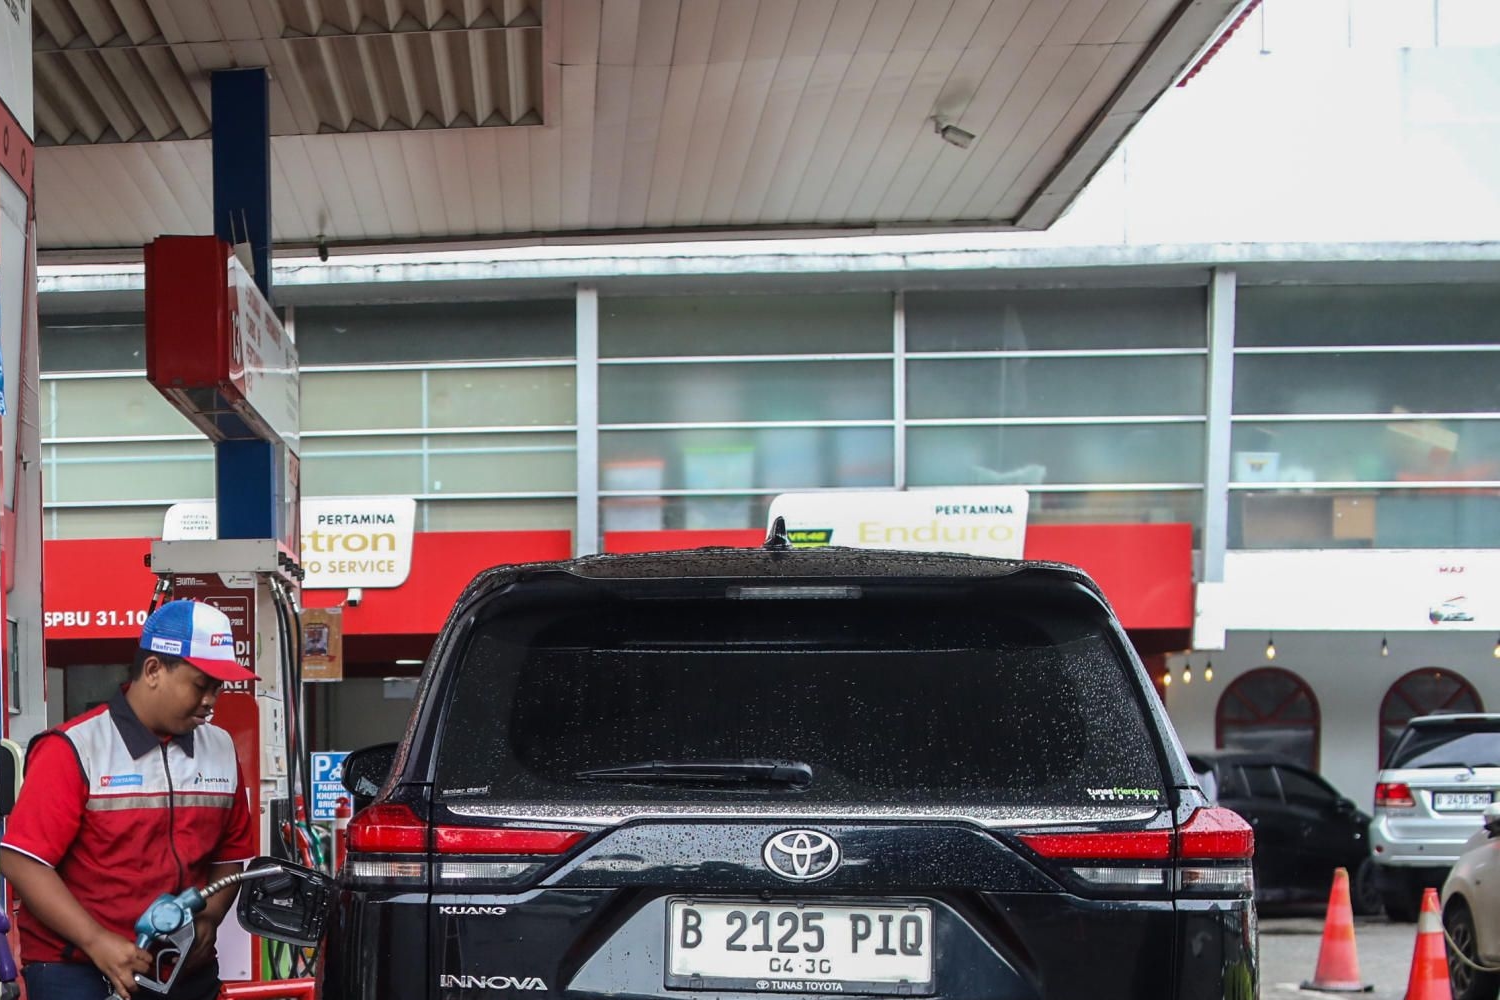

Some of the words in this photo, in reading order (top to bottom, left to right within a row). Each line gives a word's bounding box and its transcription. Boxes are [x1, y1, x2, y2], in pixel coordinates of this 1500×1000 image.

[935, 505, 1013, 514] PERTAMINA
[318, 514, 396, 526] PERTAMINA
[858, 520, 1014, 544] Enduro
[300, 529, 396, 552] tron
[328, 560, 395, 574] SERVICE
[44, 606, 90, 628] SPBU
[315, 755, 330, 781] P
[318, 783, 345, 791] PARKIN
[1086, 786, 1160, 796] tunasfriend.com
[315, 809, 326, 817] OIL
[680, 908, 702, 949] B
[726, 910, 825, 953] 2125
[850, 913, 923, 956] PIQ
[440, 974, 548, 990] INNOVA
[771, 981, 803, 990] TUNAS
[805, 981, 843, 991] TOYOTA
